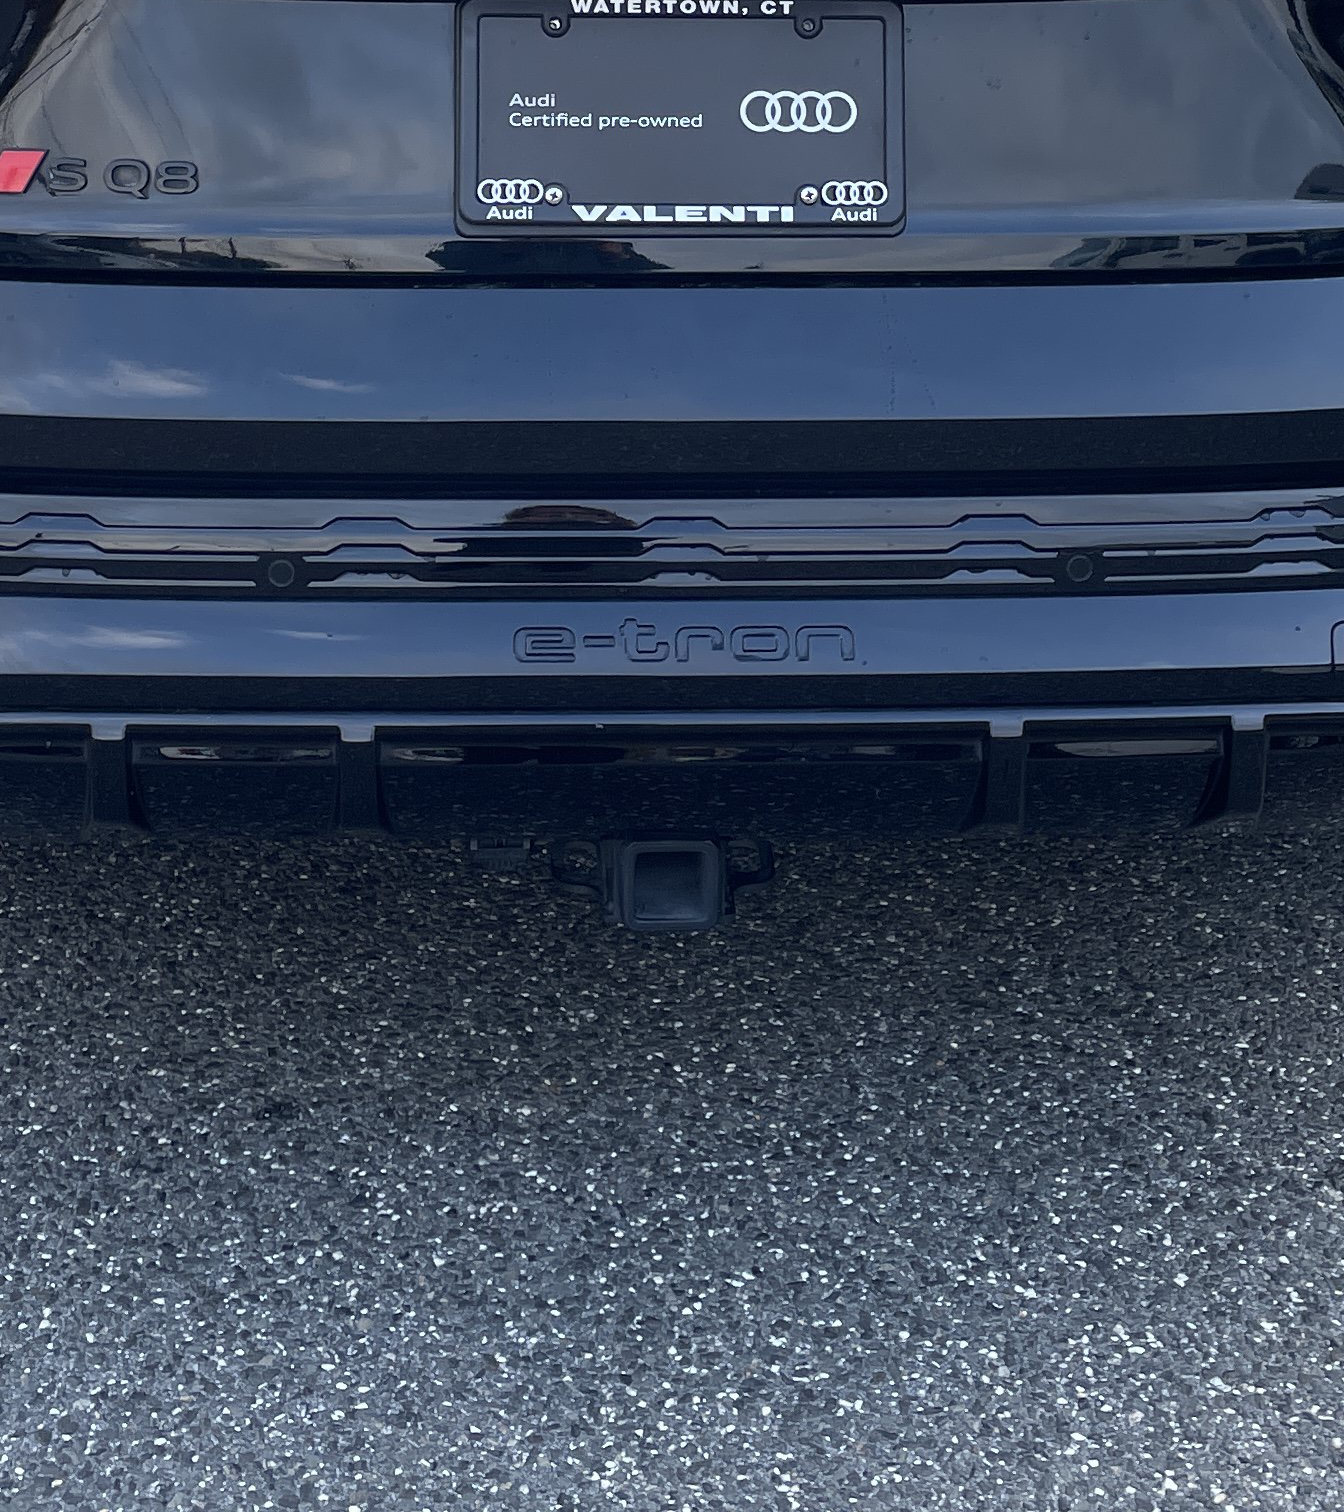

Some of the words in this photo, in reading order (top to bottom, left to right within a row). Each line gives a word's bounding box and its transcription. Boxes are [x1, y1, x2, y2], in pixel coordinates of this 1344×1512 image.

[571, 0, 749, 16] WATERTOWN,
[760, 0, 795, 16] CT
[509, 93, 556, 108] Audi
[508, 112, 593, 128] Certified
[598, 113, 703, 131] pre-owned
[485, 205, 533, 220] Audi
[570, 204, 795, 223] VALENTI
[830, 207, 879, 223] Audi
[512, 617, 855, 664] e-tron
